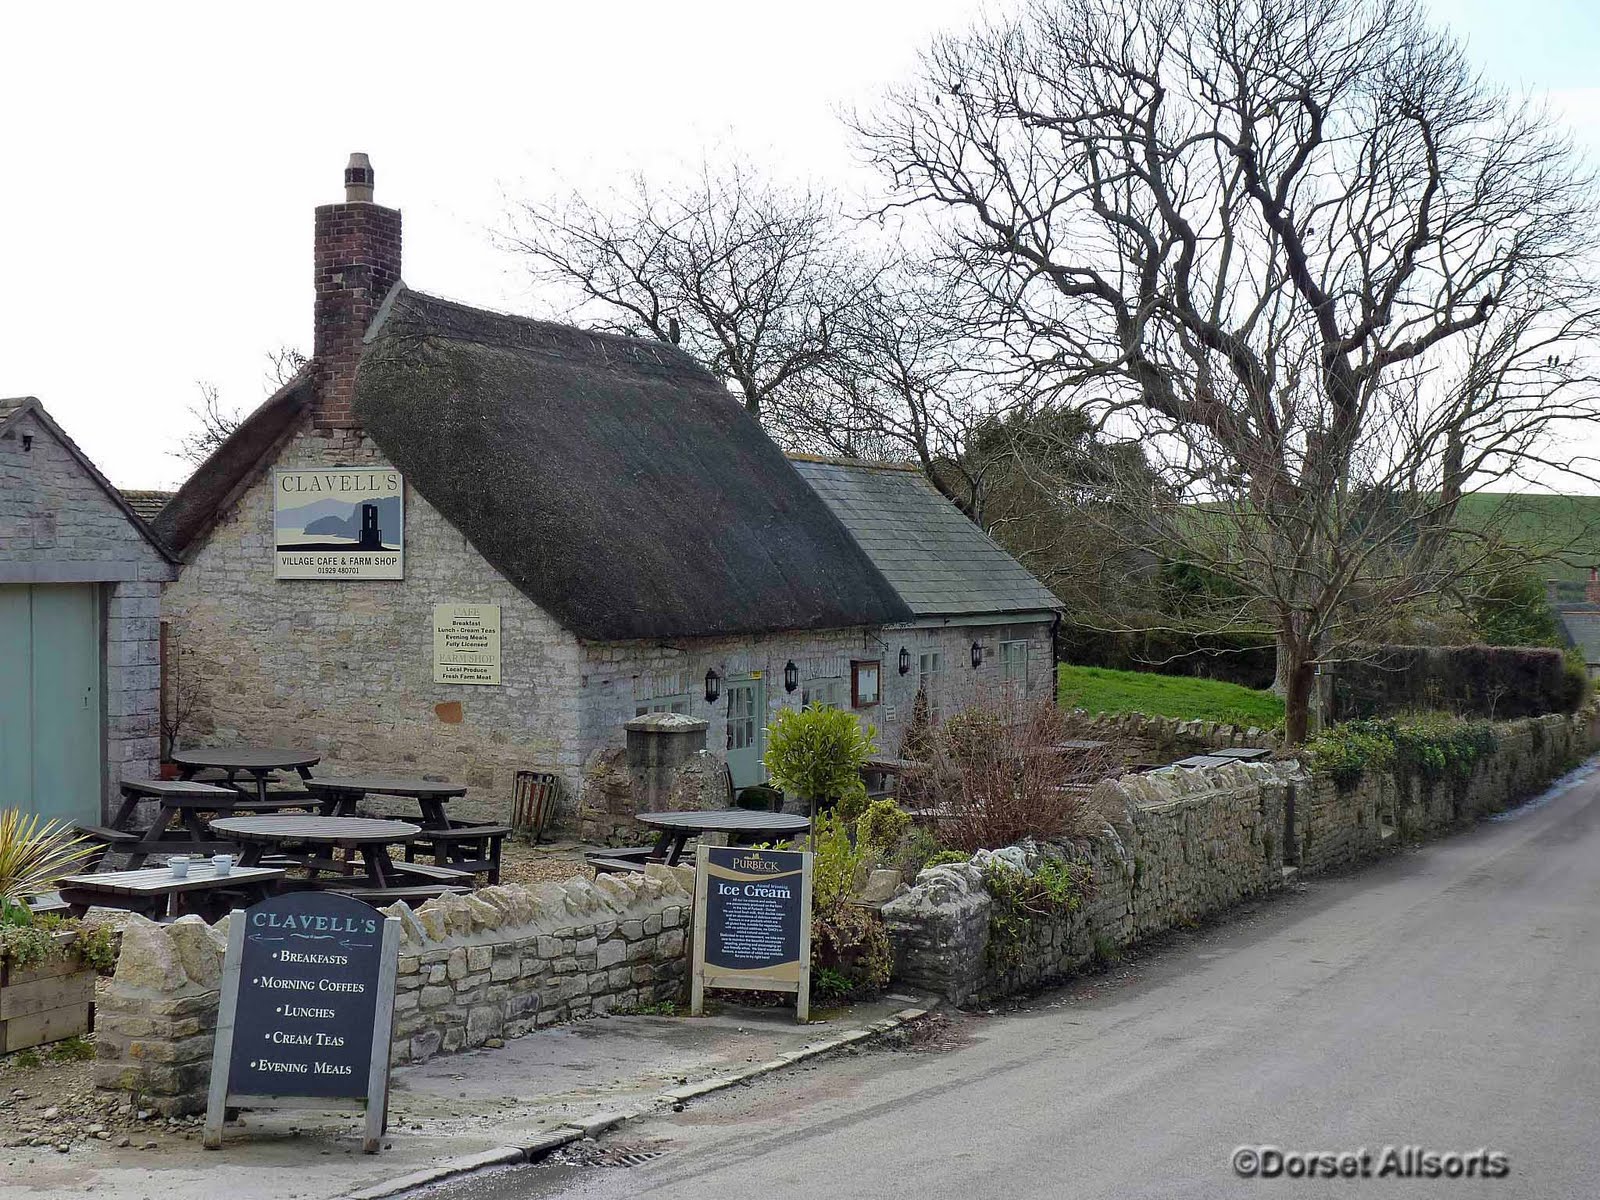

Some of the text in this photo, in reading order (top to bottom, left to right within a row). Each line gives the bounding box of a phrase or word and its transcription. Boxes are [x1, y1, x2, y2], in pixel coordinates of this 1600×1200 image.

[282, 474, 398, 492] CLAVELL'S
[282, 557, 398, 566] VILLAGE CAFE & FARM SHOP
[468, 655, 495, 663] SHOP
[733, 857, 781, 872] PURBECK
[718, 883, 791, 899] Ice Cream
[252, 912, 376, 934] CLAVELL'S
[280, 950, 348, 965] BREAKFASTS
[261, 976, 365, 993] MORNING COFFEES
[284, 1005, 335, 1019] LUNCHES
[273, 1031, 344, 1047] CREAM TEAS
[258, 1059, 352, 1075] EVENING MEALS
